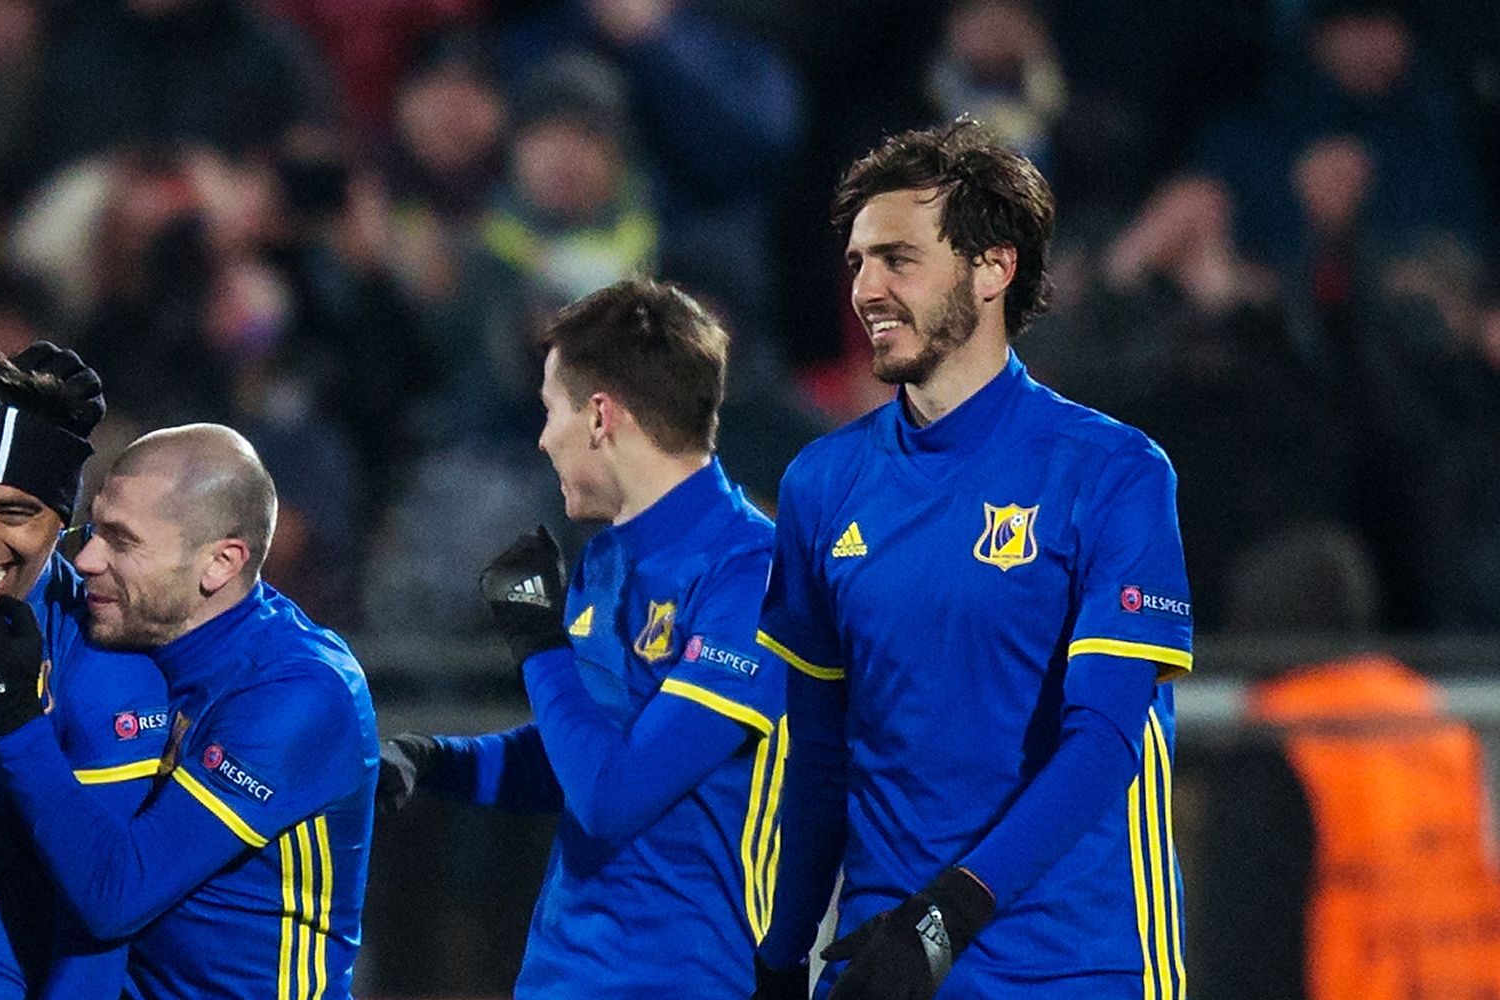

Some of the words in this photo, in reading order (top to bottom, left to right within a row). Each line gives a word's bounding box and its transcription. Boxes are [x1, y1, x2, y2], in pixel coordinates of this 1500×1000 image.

[1143, 595, 1190, 616] RESPECT
[701, 646, 759, 676] RESPECT
[219, 760, 274, 802] RESPECT
